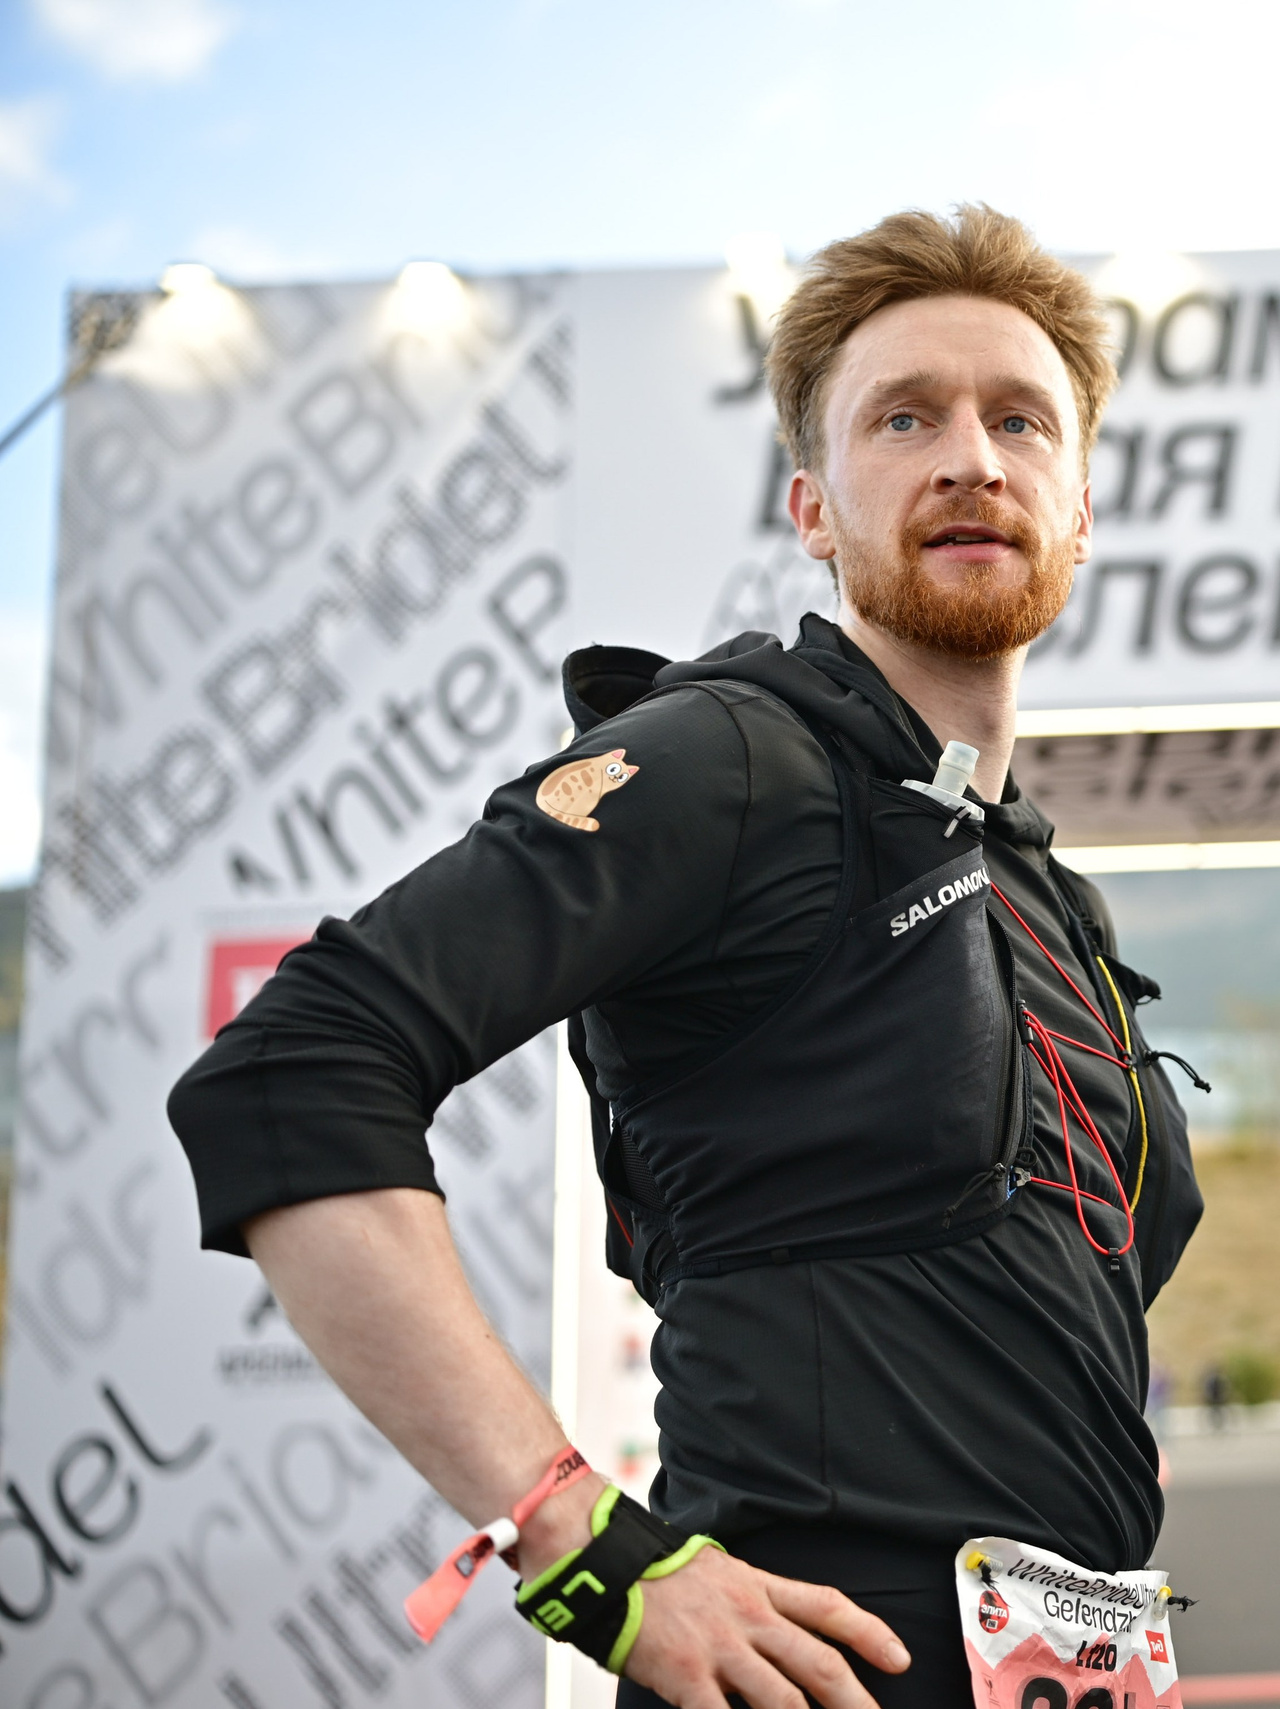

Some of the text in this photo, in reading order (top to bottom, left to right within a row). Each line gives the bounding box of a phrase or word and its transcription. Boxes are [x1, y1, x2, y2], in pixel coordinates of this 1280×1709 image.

[890, 867, 991, 937] SALOMON
[1007, 1558, 1157, 1609] WhiteBrideUltr
[981, 1603, 1008, 1618] ЭЛИТА
